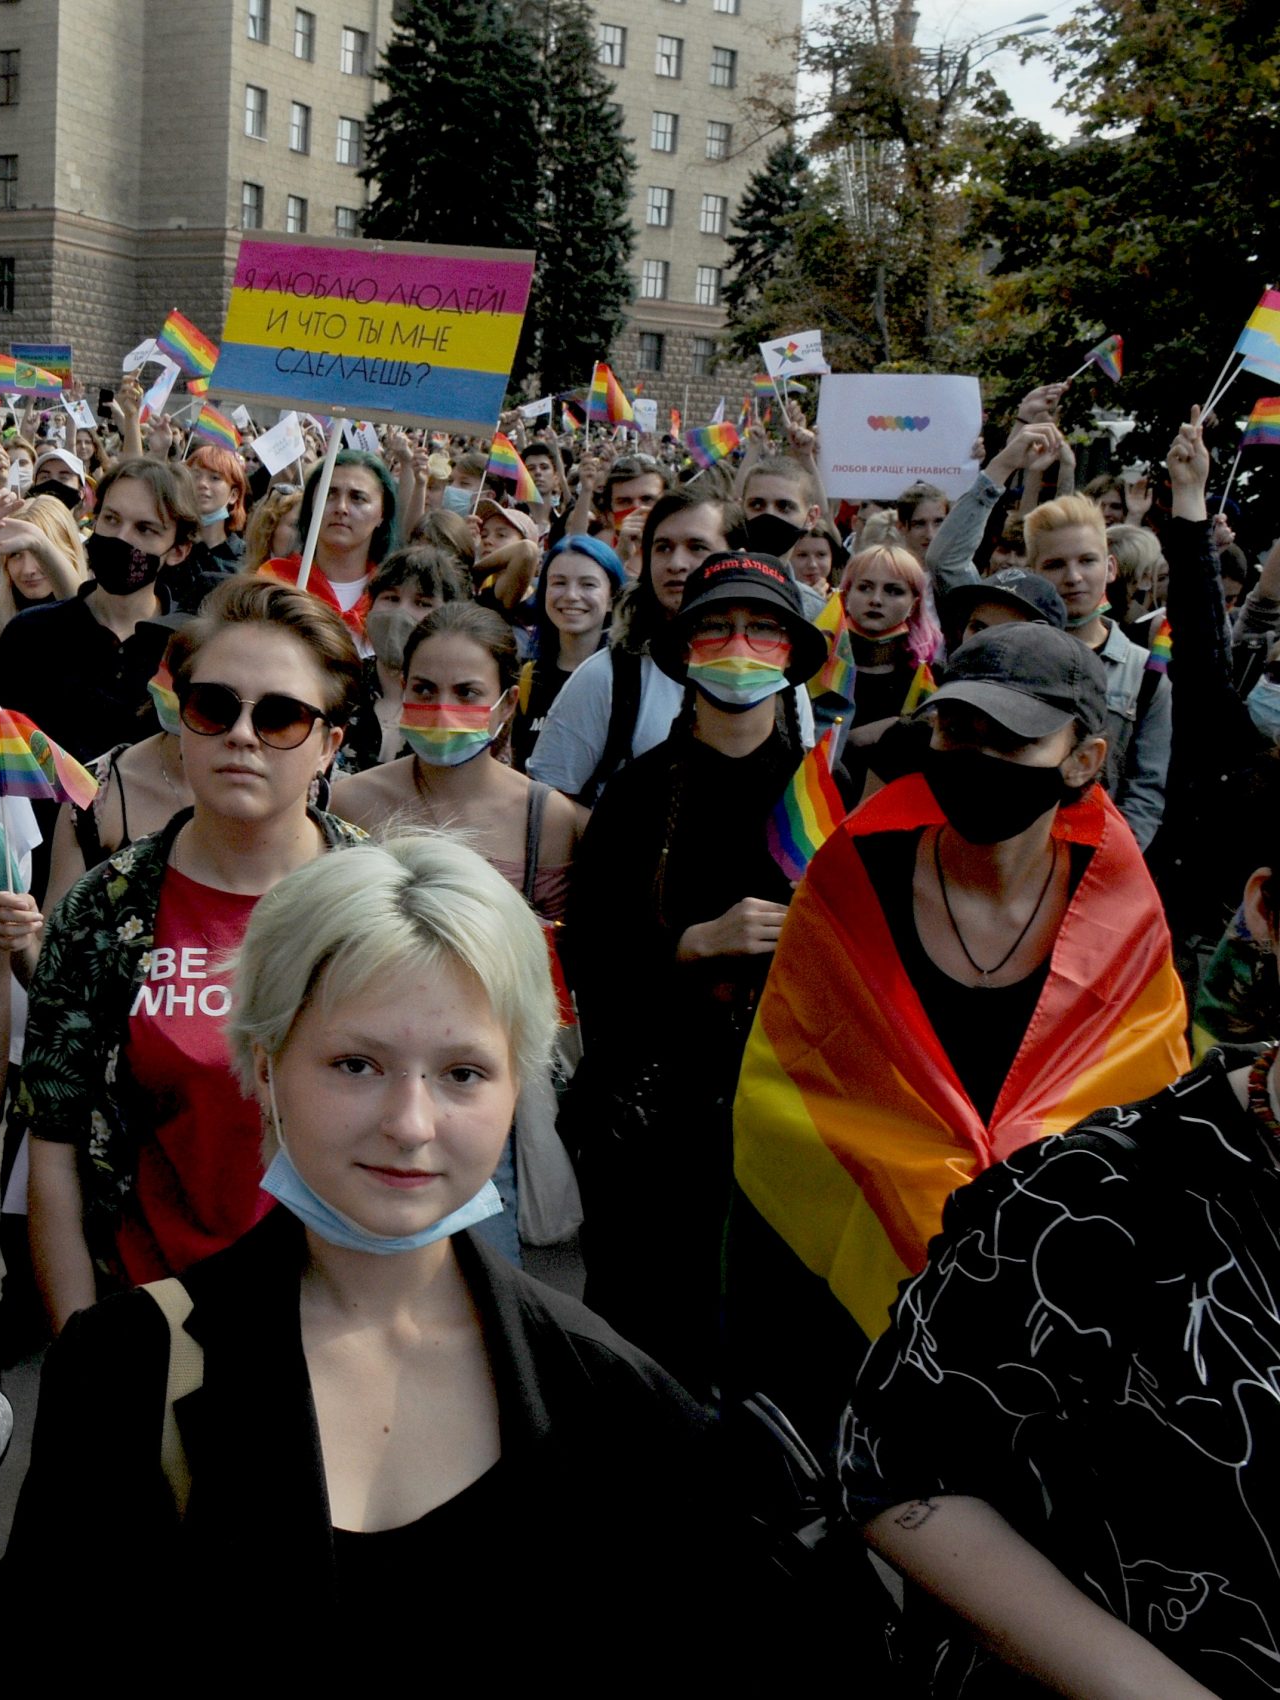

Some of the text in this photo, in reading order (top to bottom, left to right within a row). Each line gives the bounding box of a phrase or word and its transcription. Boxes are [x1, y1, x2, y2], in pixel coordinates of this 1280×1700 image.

[243, 268, 507, 317] Я ЛЮБЛЮ ЛЮДЕЙ!
[265, 308, 453, 353] И ЧТО ТЫ МНЕ
[275, 346, 432, 389] СДЕЛАЕШЬ?
[831, 464, 868, 474] ЛЮБОВ
[870, 465, 904, 475] КРАЩЕ
[150, 946, 208, 982] BE
[128, 983, 232, 1017] WHO
